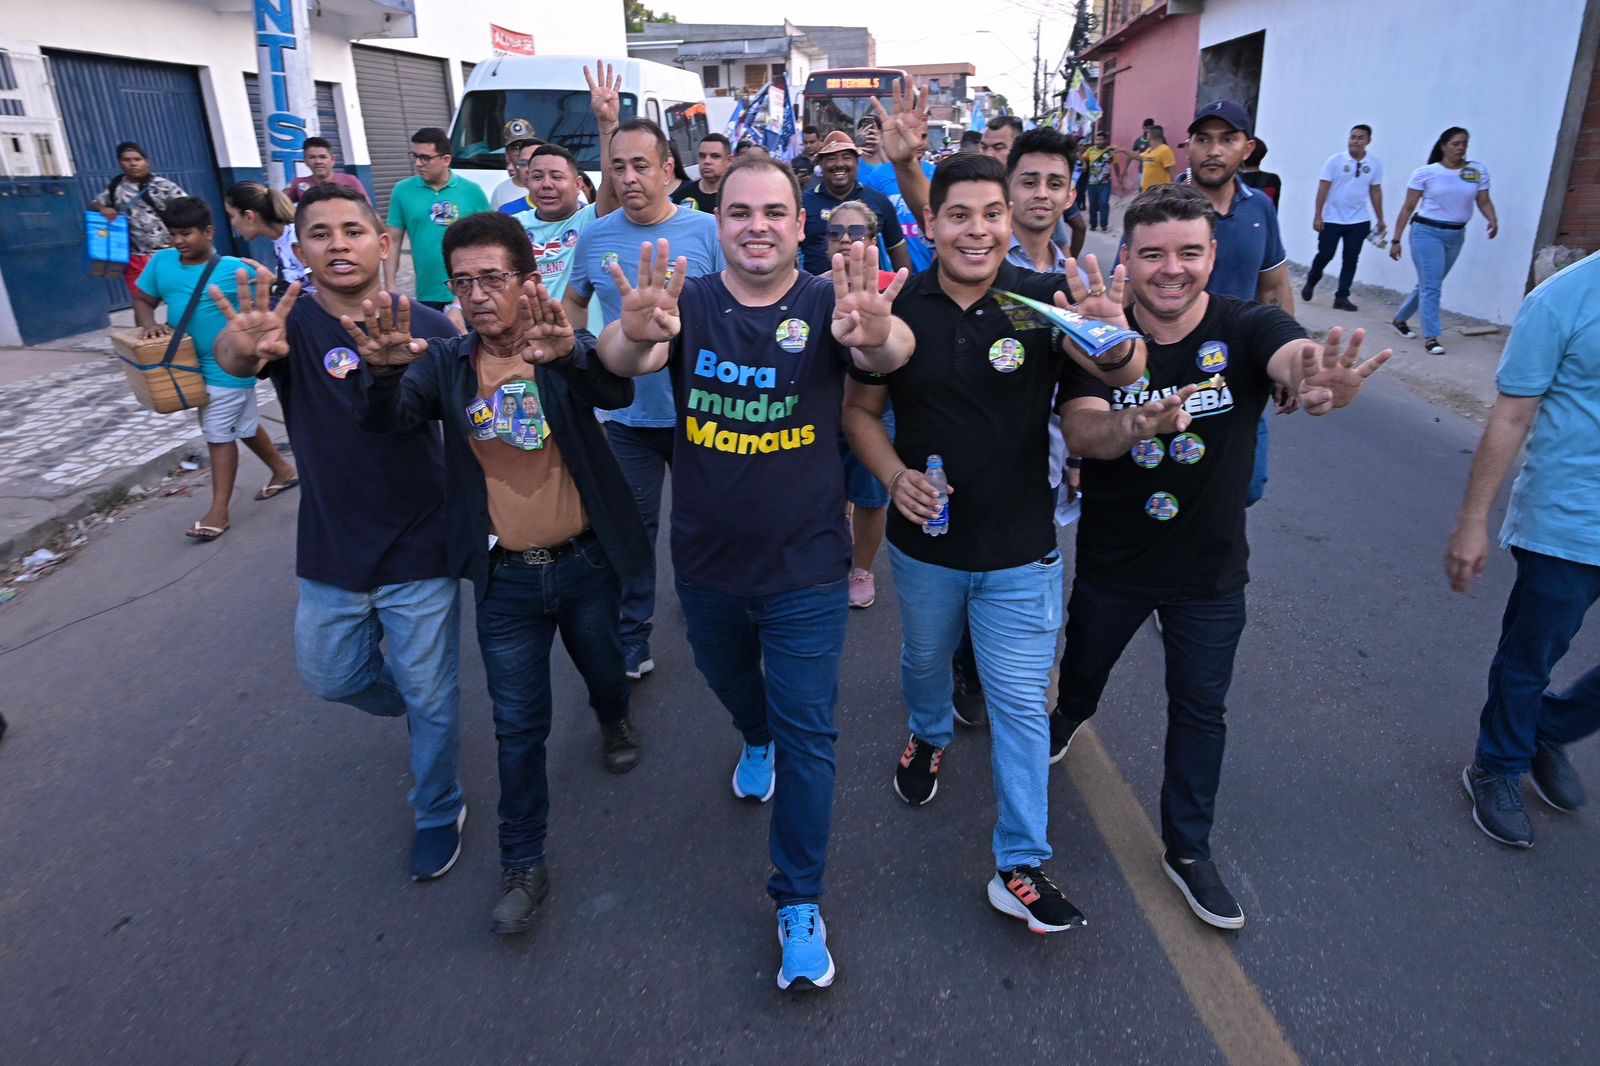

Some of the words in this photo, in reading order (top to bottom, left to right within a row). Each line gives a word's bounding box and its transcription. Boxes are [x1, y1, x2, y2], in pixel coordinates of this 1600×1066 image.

[694, 349, 776, 389] Bora
[687, 388, 800, 423] mudar
[686, 416, 816, 455] Manaus
